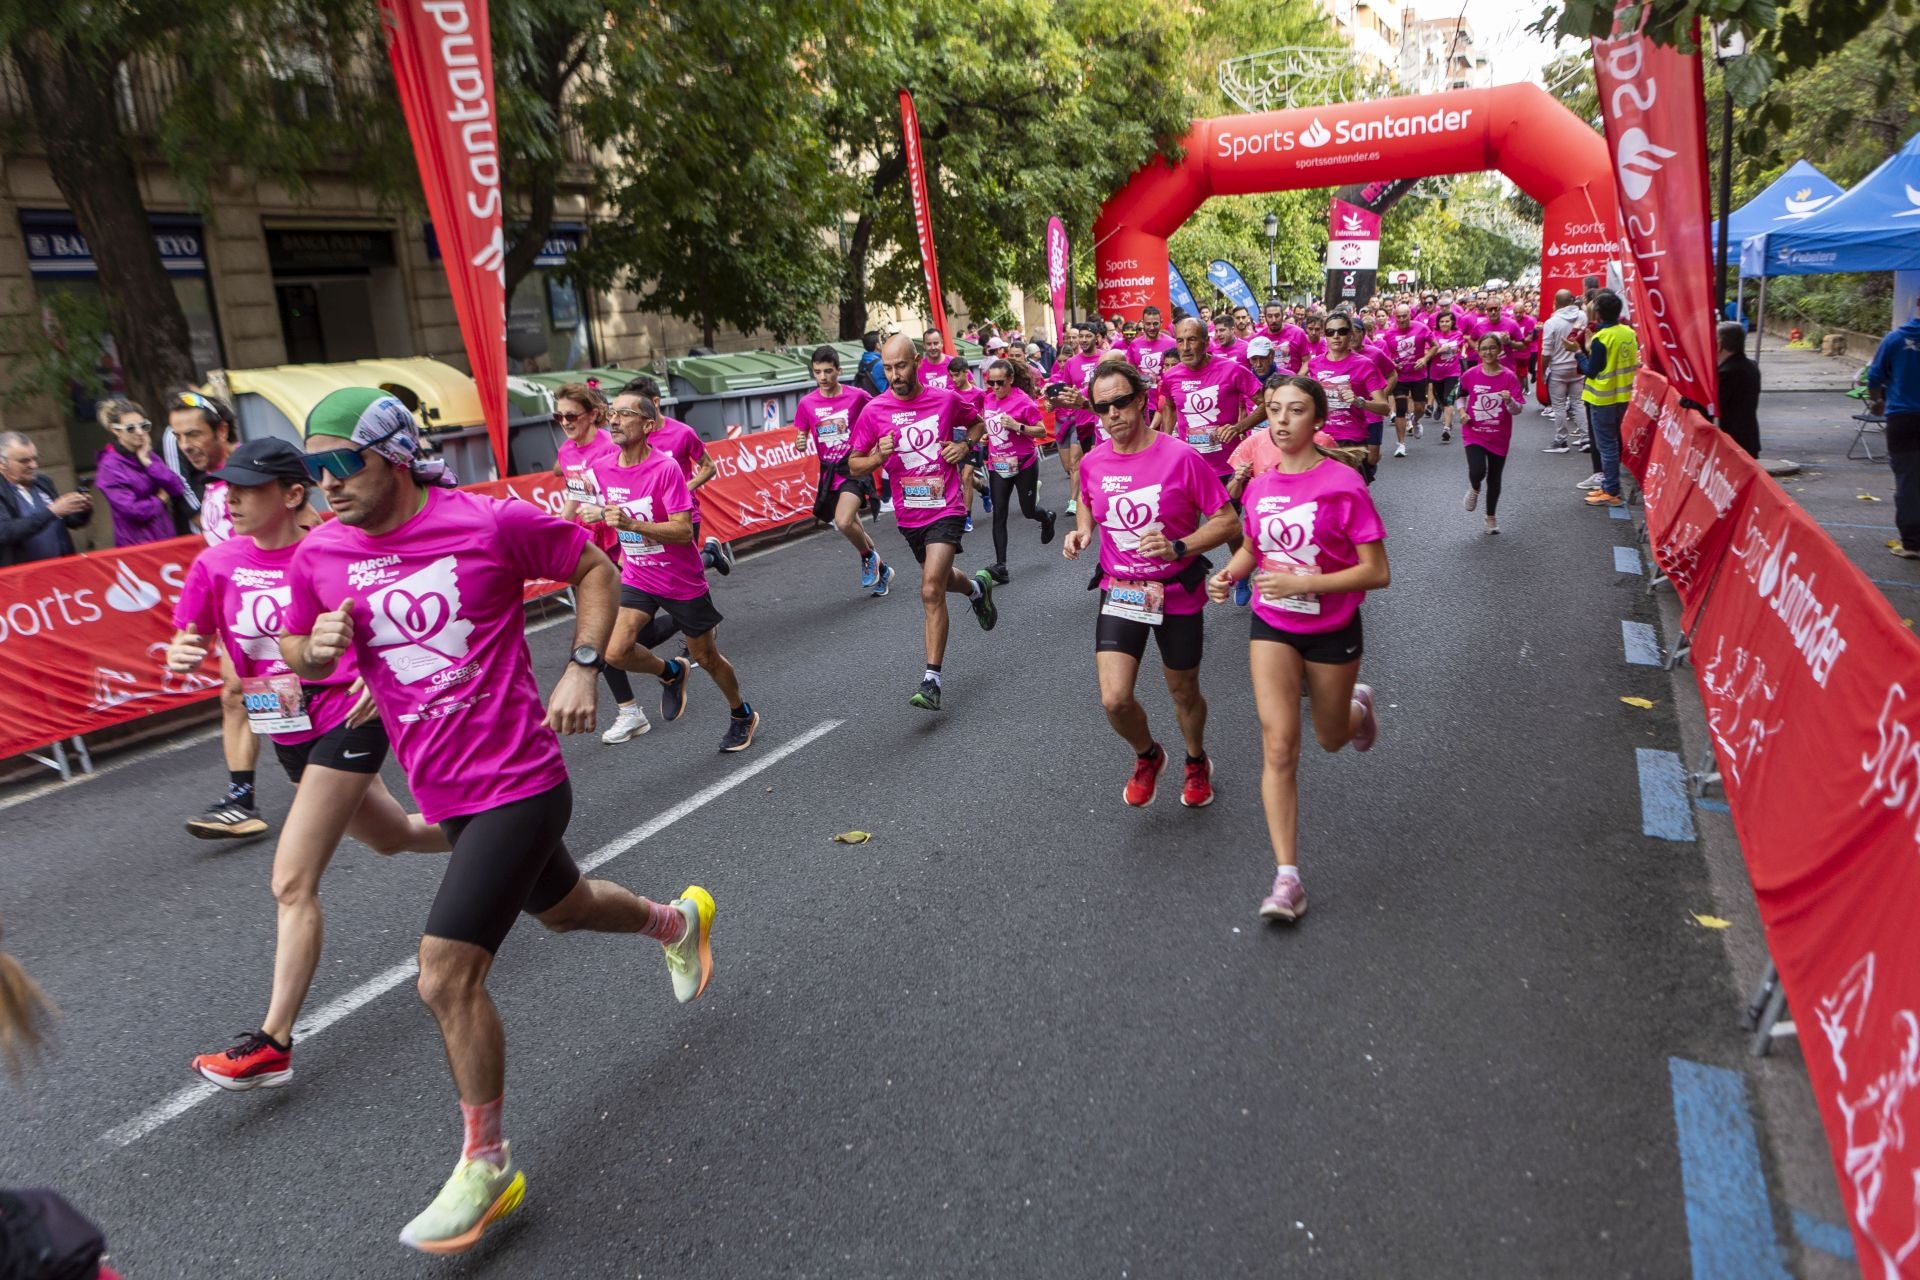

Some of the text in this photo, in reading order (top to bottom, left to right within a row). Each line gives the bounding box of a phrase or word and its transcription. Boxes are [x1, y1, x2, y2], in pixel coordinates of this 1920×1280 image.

[1218, 108, 1473, 161] Sports Santander
[1296, 151, 1380, 169] sportssantander.es
[1564, 222, 1606, 237] Sports
[1105, 259, 1138, 273] Sports
[1103, 275, 1155, 289] Santander
[1101, 475, 1133, 483] MARCHA
[347, 554, 403, 575] MARCHA
[1111, 588, 1146, 604] 0432
[1769, 551, 1847, 690] Santander
[431, 660, 480, 685] CÁCERES
